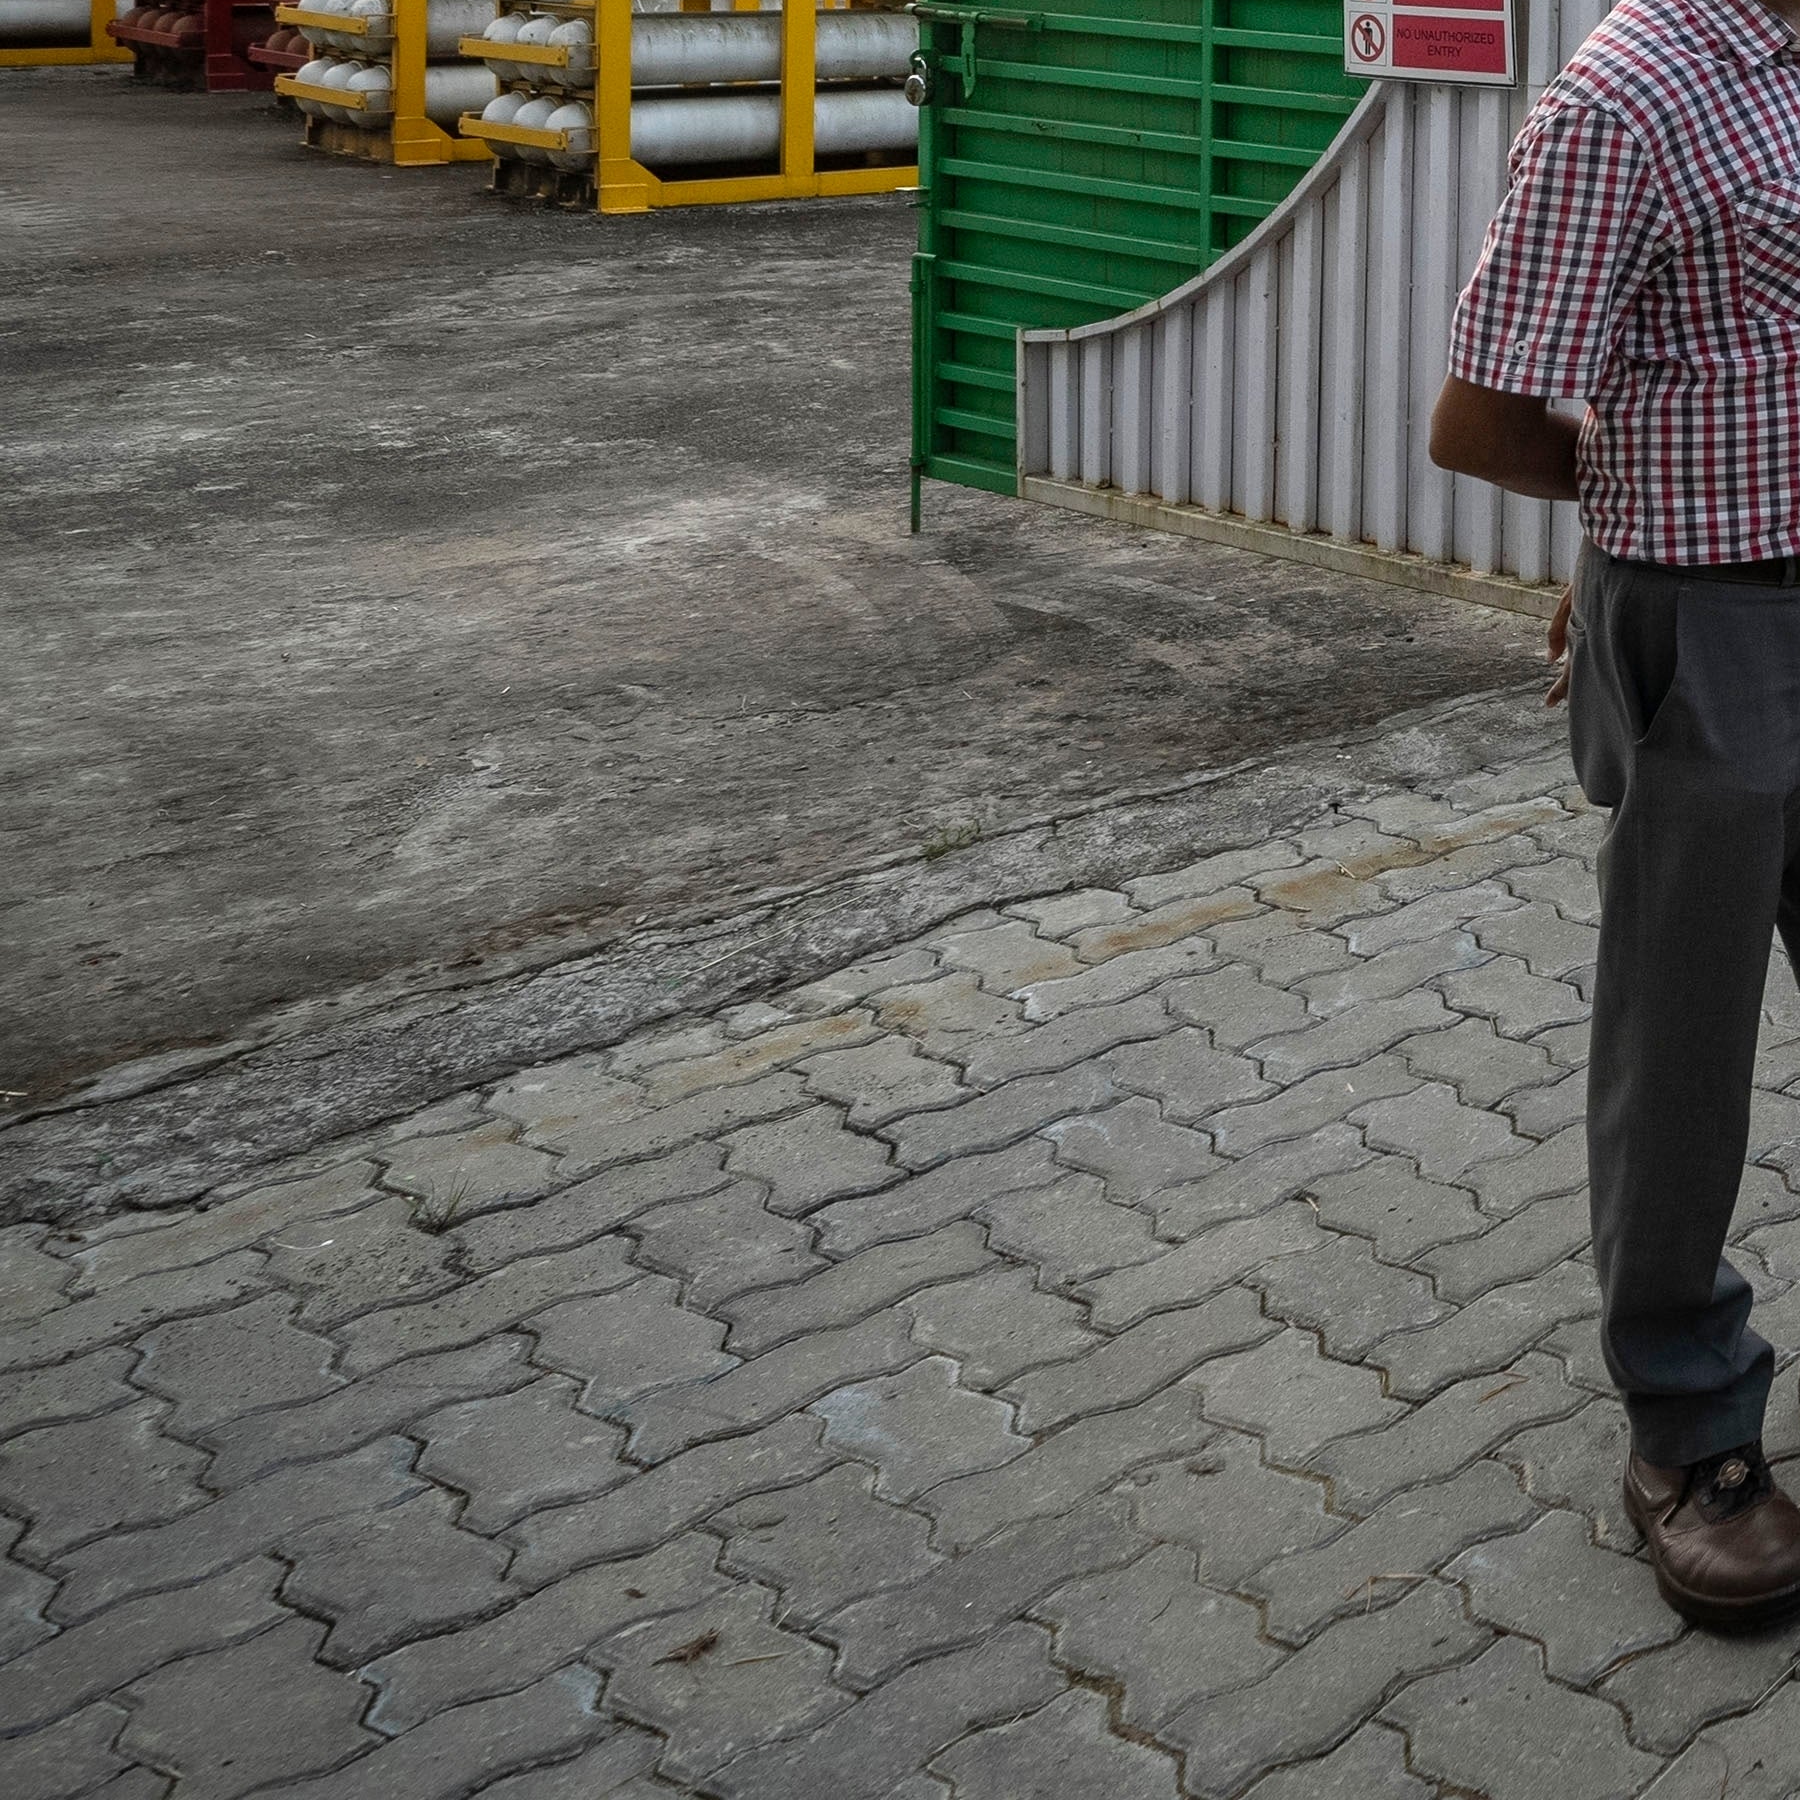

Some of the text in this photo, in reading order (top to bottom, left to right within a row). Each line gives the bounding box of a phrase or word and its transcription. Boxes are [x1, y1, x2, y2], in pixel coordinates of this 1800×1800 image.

[1396, 28, 1496, 45] NO UNAUTHORIZED
[1427, 45, 1463, 58] ENTRY
